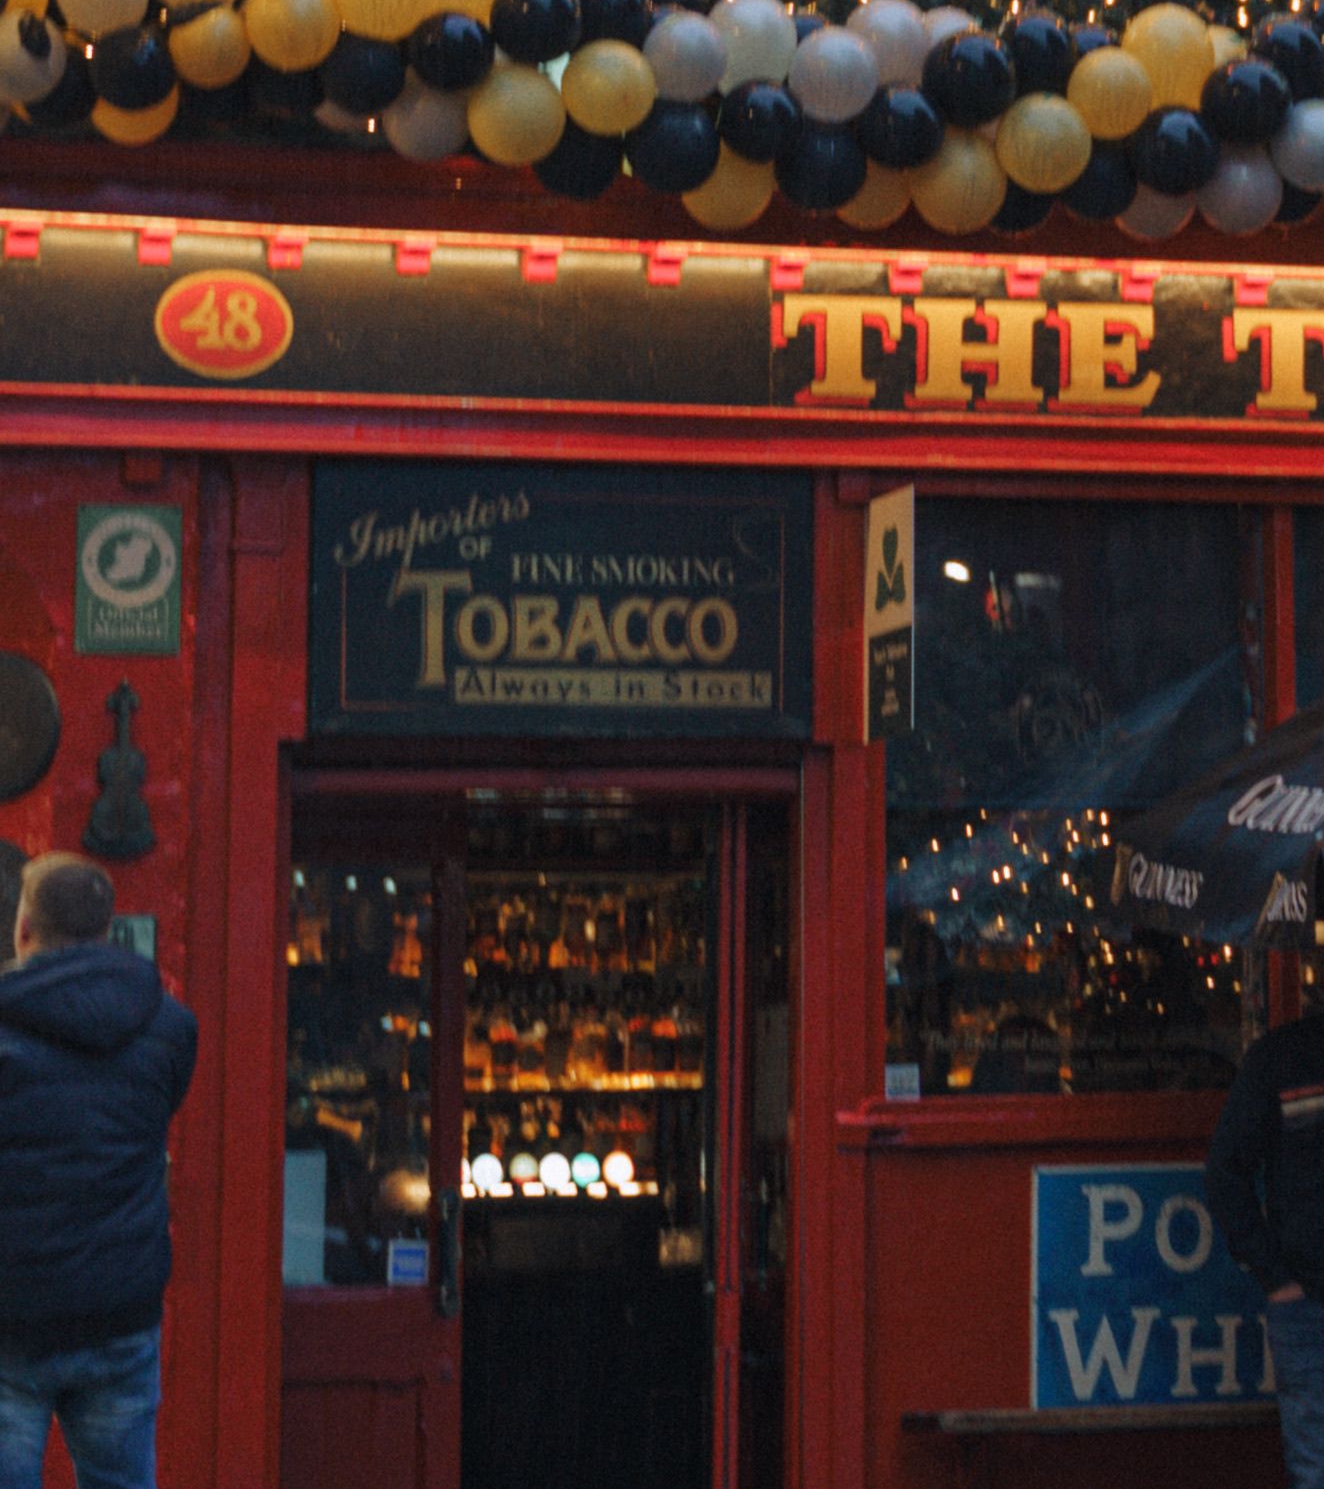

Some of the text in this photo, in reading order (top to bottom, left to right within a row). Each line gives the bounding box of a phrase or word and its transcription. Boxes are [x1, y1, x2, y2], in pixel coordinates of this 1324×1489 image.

[180, 284, 262, 352] 48
[772, 294, 1161, 412] THE
[334, 487, 530, 576] Importers
[459, 535, 492, 561] OF
[512, 553, 735, 587] FINE SMOKING
[395, 569, 738, 690] TOBACCO
[461, 668, 590, 702] Always
[662, 670, 765, 702] Stock
